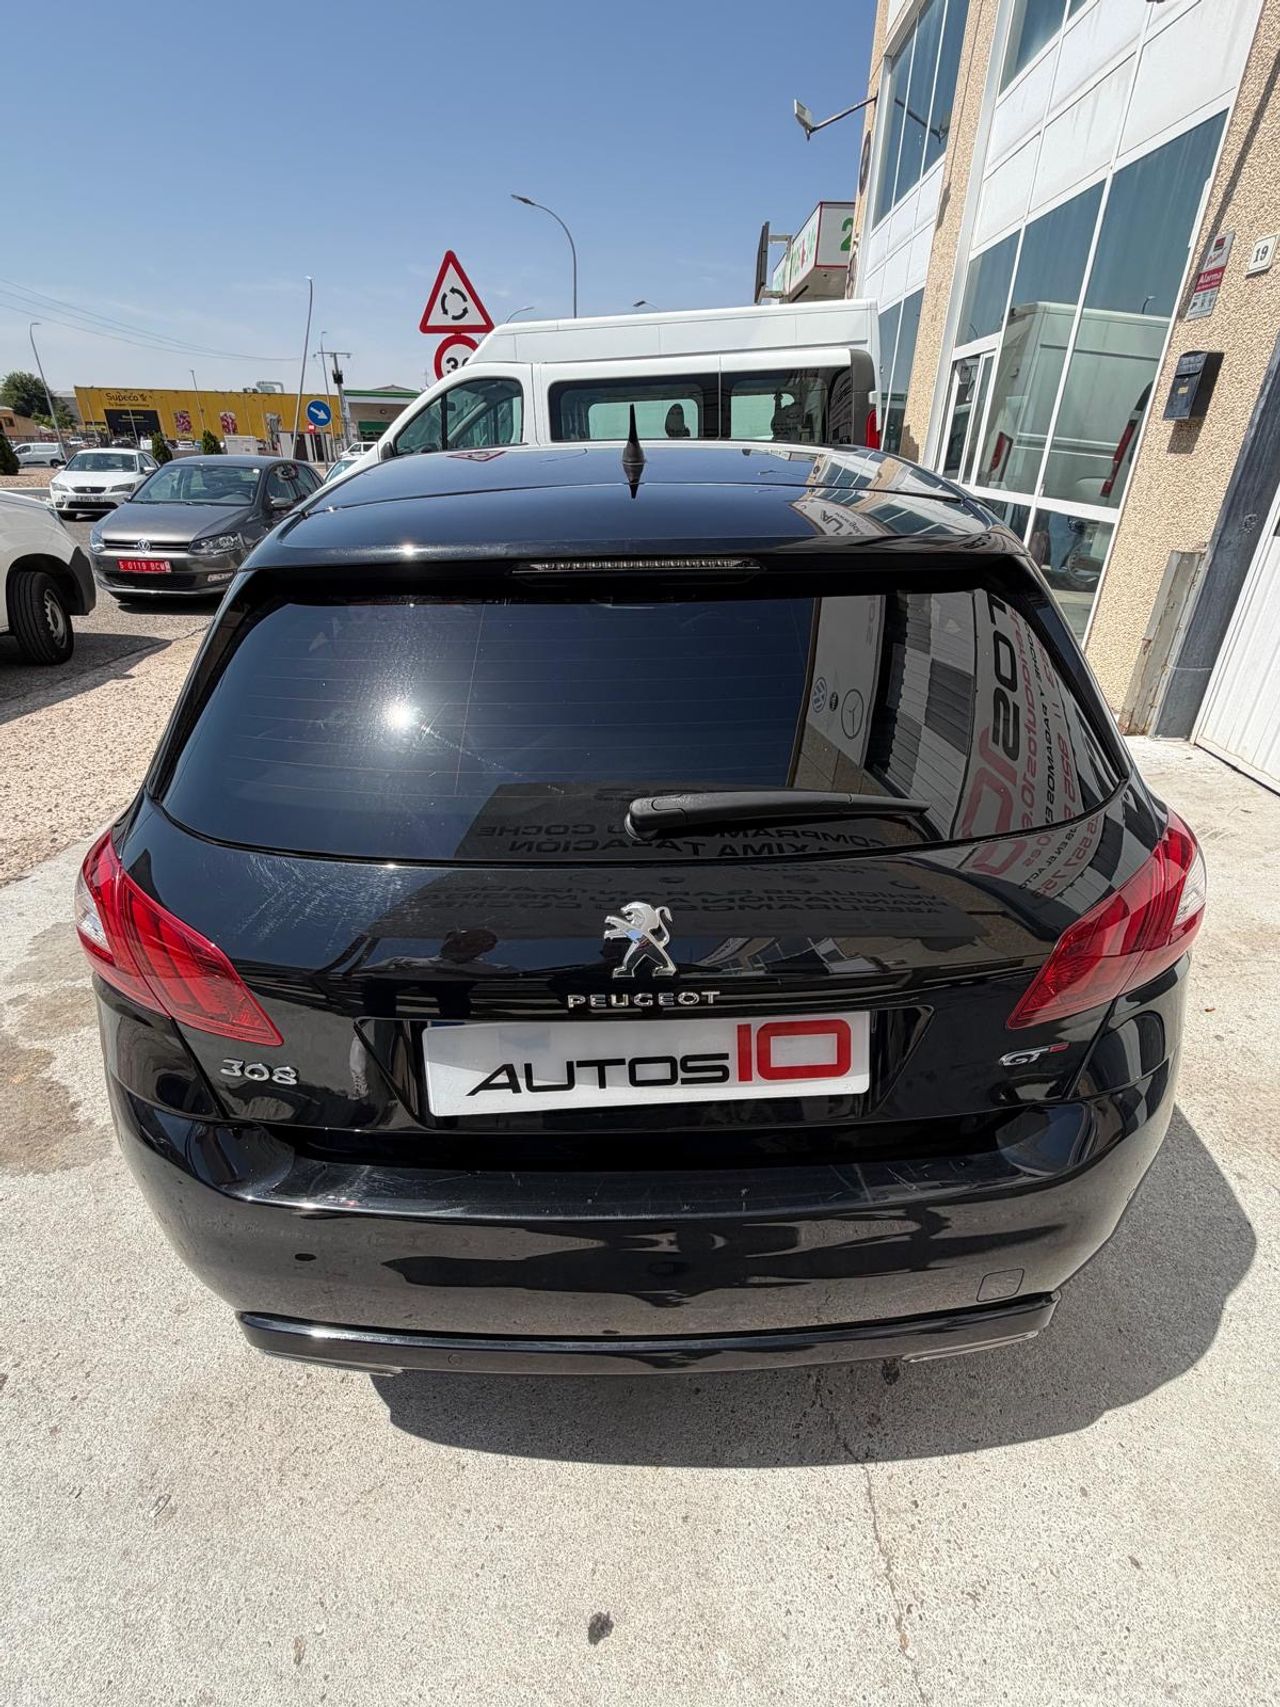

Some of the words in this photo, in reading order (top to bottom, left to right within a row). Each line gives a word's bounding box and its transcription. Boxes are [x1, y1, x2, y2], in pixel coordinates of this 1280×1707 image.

[1253, 245, 1269, 264] 19
[568, 991, 720, 1009] PEUGEOT
[220, 1058, 298, 1086] 308
